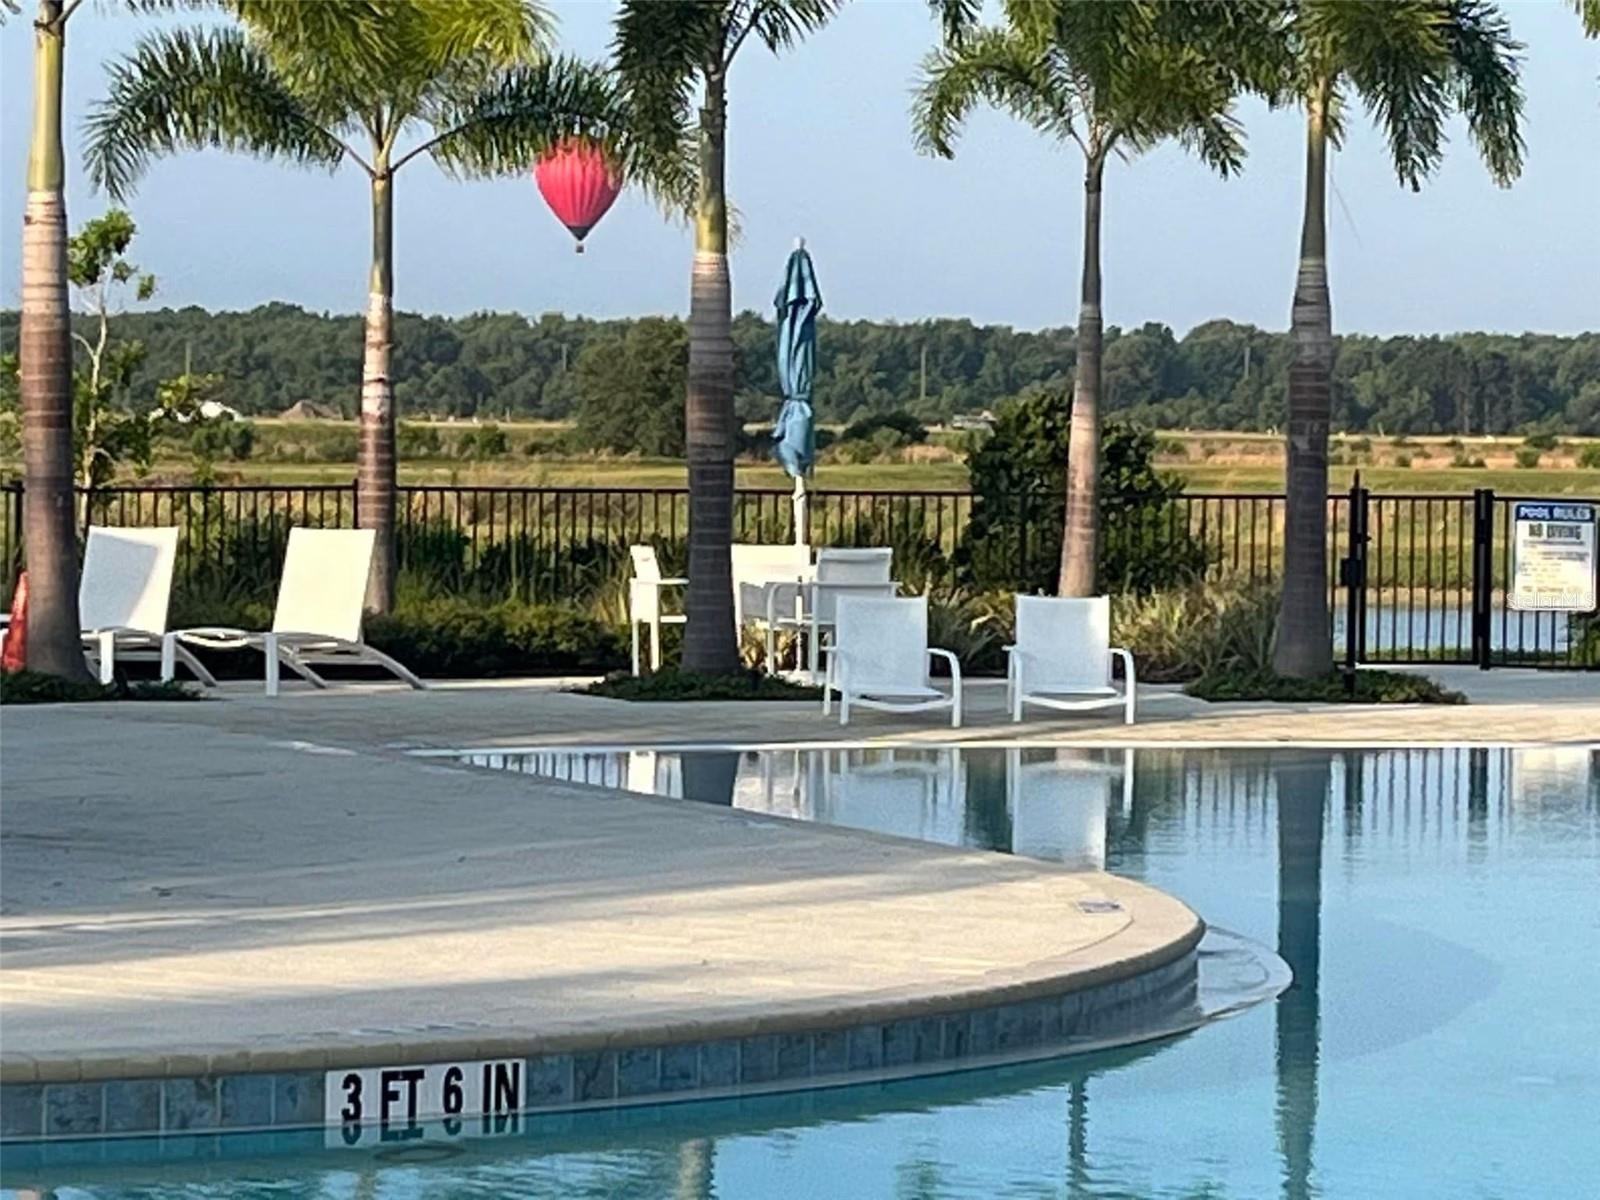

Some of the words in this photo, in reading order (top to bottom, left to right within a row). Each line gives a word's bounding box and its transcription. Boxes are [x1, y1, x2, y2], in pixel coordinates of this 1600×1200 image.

[341, 1073, 362, 1121] 3
[381, 1068, 425, 1123] FT
[444, 1066, 463, 1114] 6
[483, 1062, 520, 1113] IN
